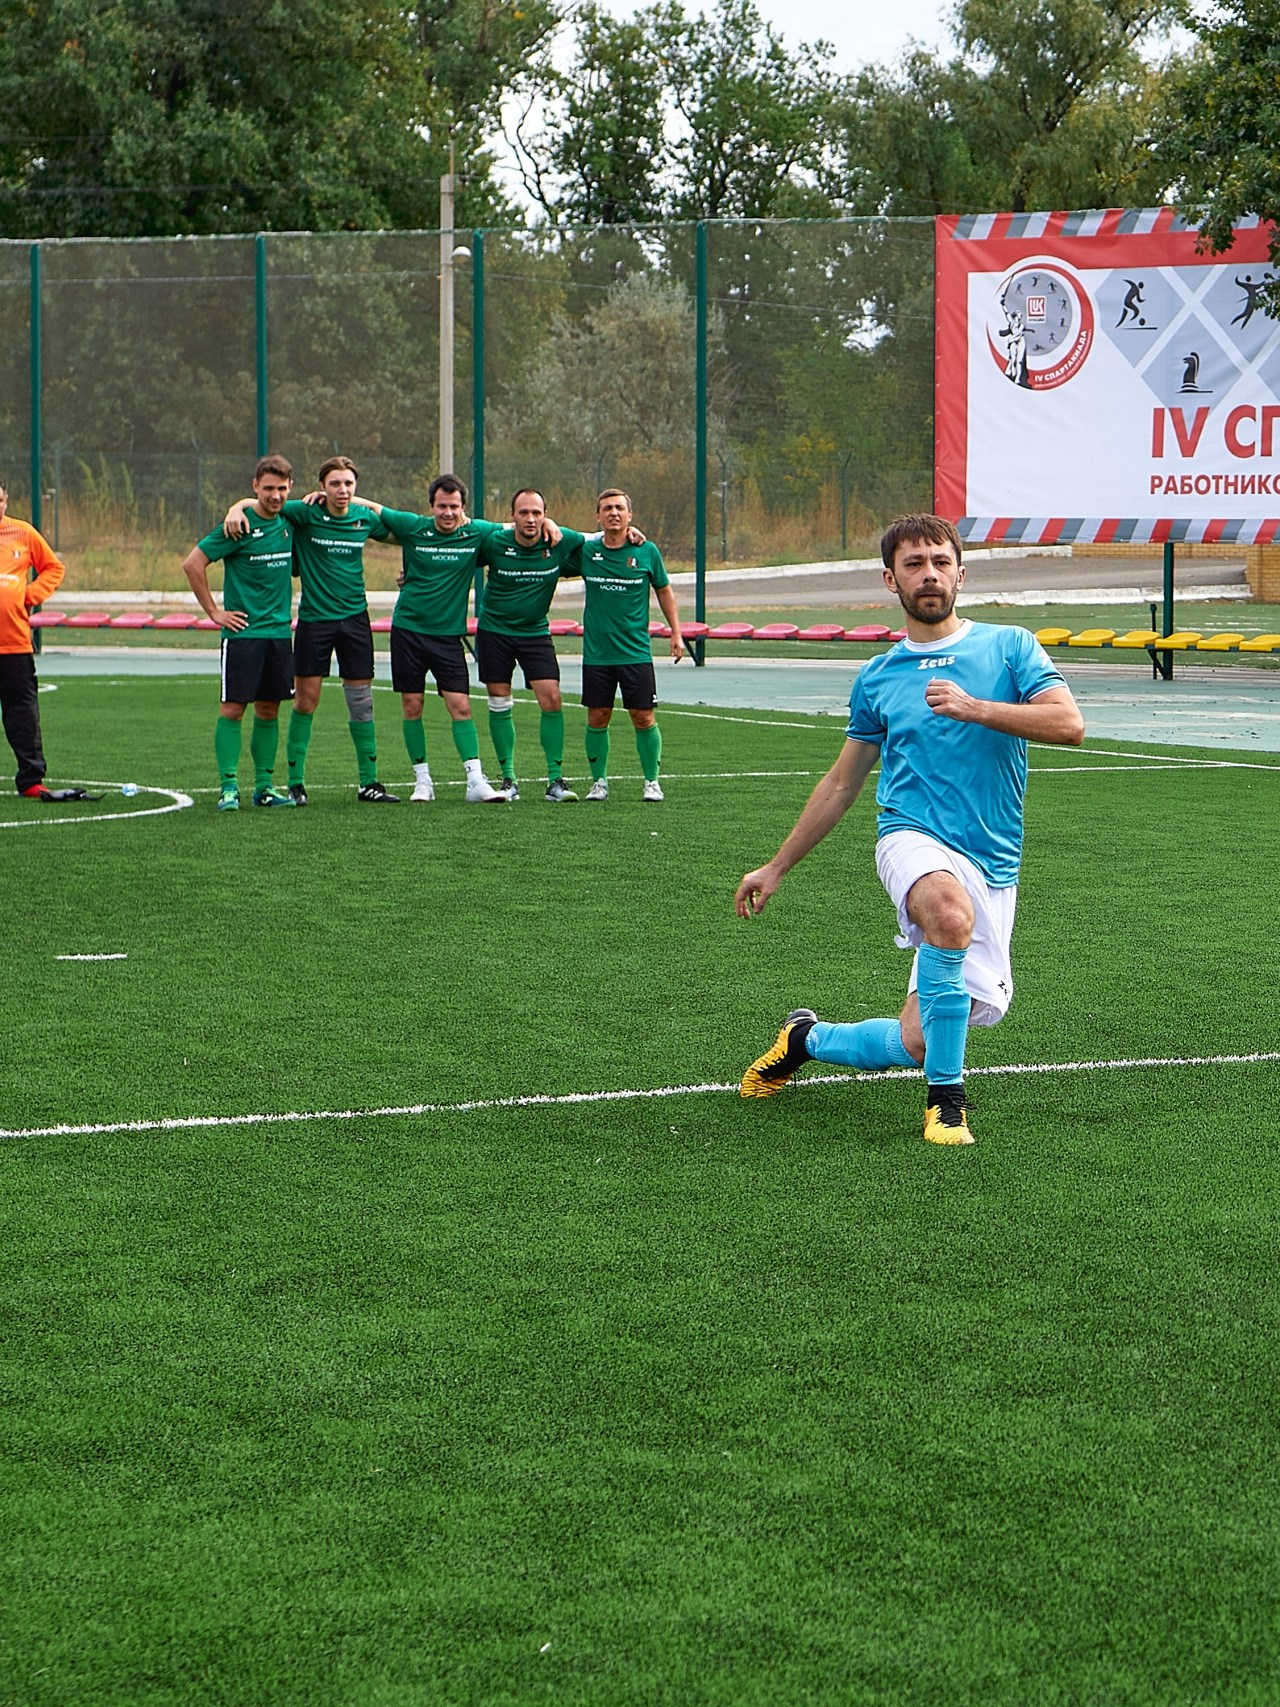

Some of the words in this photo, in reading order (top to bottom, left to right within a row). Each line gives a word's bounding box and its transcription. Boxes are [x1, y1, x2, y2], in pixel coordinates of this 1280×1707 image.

[1044, 330, 1088, 381] СПАРТАКИАДА
[1152, 406, 1211, 458] IV
[917, 655, 955, 670] Zeus
